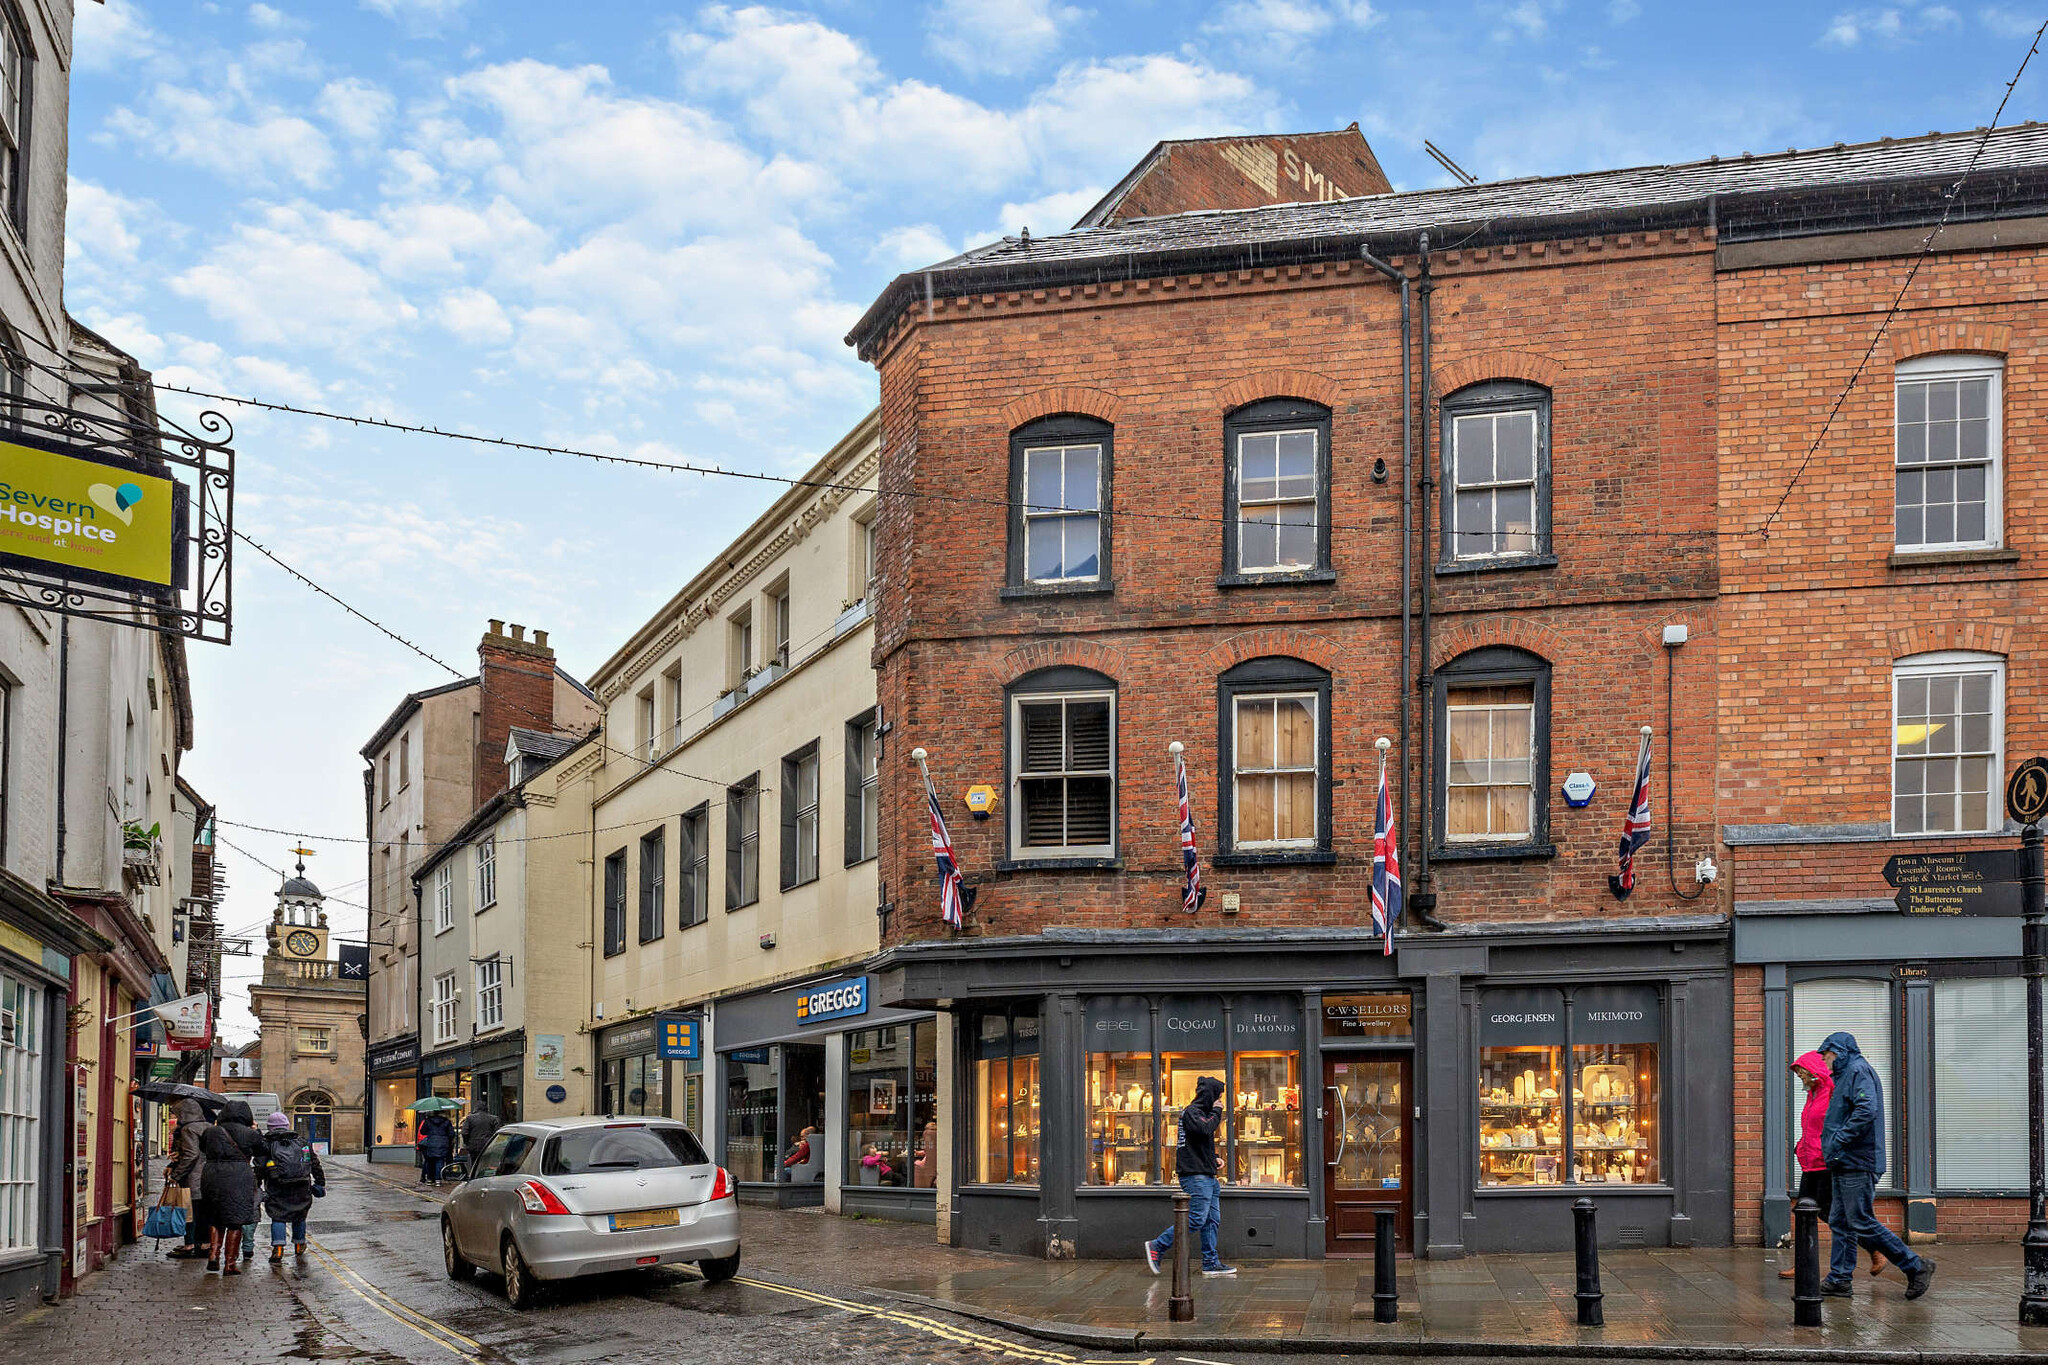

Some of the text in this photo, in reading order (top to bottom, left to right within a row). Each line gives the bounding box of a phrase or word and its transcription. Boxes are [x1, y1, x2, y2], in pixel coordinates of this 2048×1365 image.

[0, 482, 94, 519] Severn
[0, 502, 116, 543] Hospice
[0, 528, 104, 555] ere and at home
[1896, 856, 1955, 866] Town Museum
[1896, 865, 1962, 875] Assembly Rooms
[1896, 875, 1919, 883] Castle
[1956, 885, 1983, 894] Church
[1909, 895, 1963, 903] The Buttercross
[1910, 905, 1963, 914] Ludlow College
[1900, 968, 1928, 978] Library
[809, 984, 862, 1015] GREGGS
[1490, 1013, 1555, 1023] GEORG JENSEN
[1588, 1011, 1643, 1021] MIKIMOTO
[1095, 1020, 1140, 1031] EBEL
[1358, 1020, 1392, 1028] Jewellery
